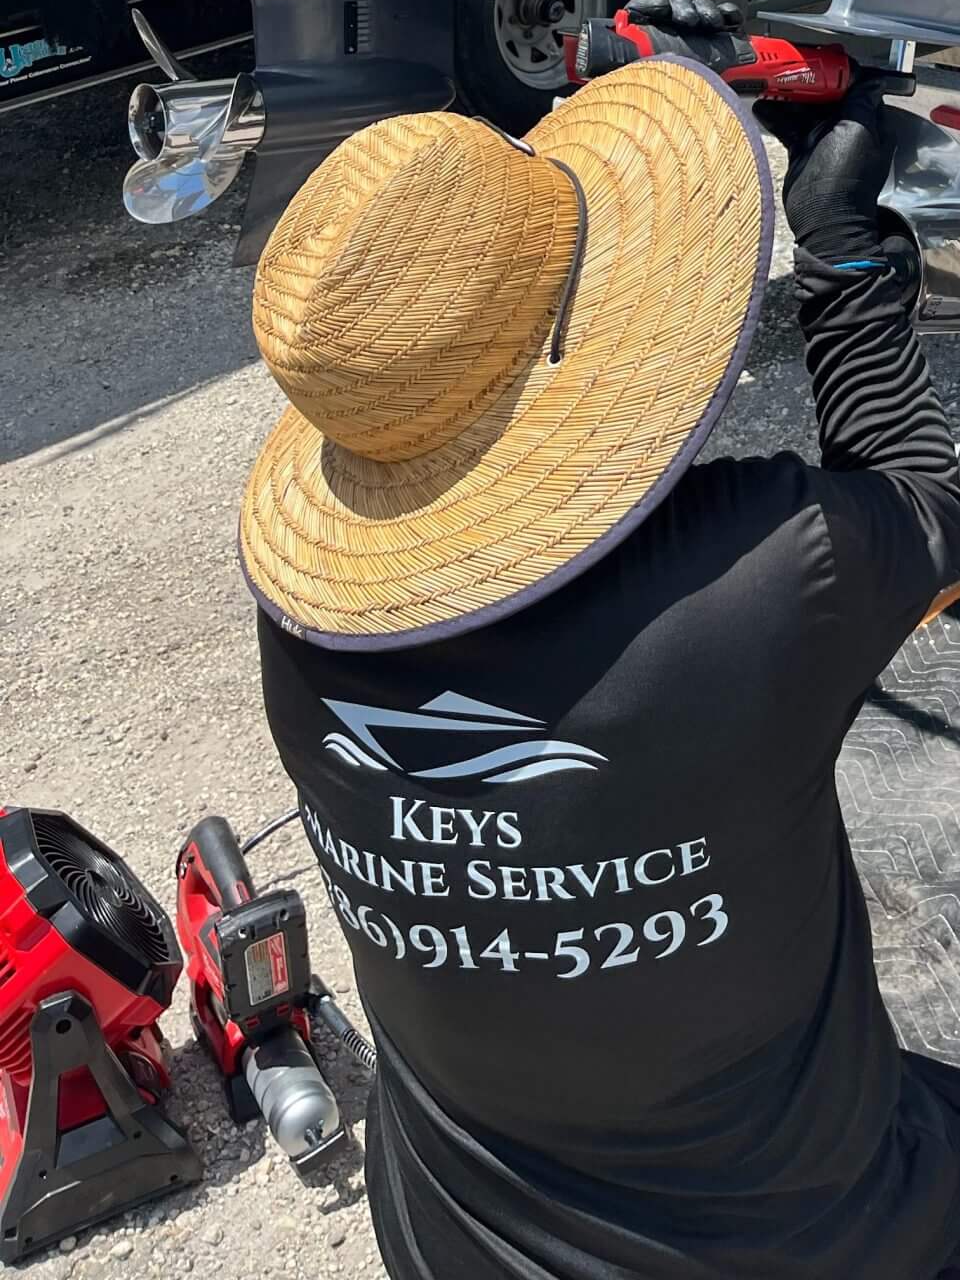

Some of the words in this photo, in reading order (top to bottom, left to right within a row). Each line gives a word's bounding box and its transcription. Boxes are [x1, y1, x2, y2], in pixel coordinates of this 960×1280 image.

[304, 804, 451, 897] MARINE
[466, 837, 712, 901] SERVICE
[389, 796, 522, 848] KEYS
